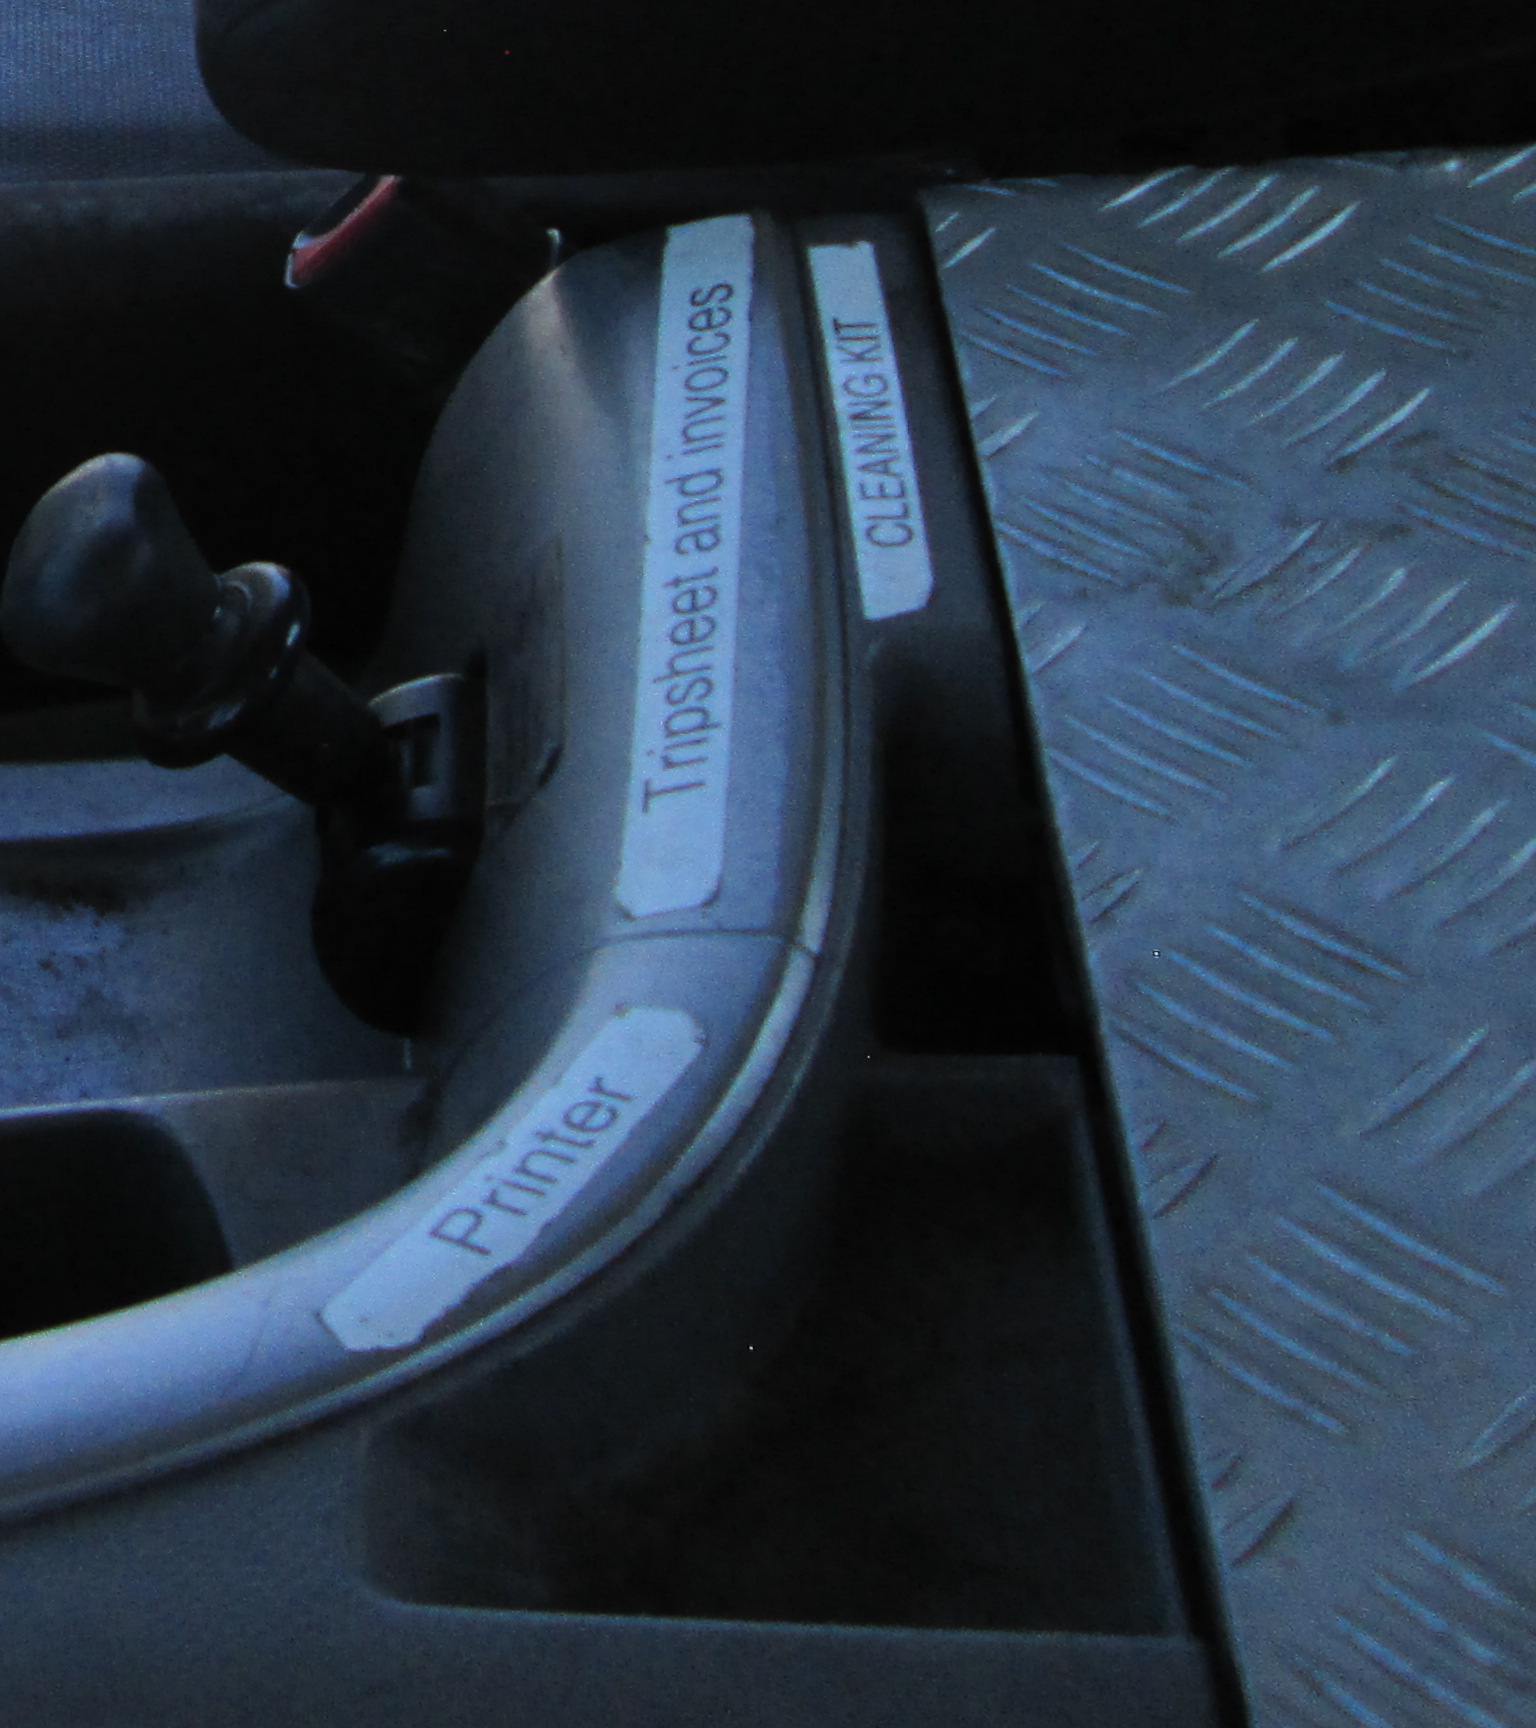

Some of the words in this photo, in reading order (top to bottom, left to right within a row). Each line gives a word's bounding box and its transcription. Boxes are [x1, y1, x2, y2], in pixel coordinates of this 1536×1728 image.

[668, 282, 733, 467] invoices
[832, 318, 885, 365] KIT
[666, 468, 723, 554] and
[839, 373, 914, 549] CLEANING
[642, 567, 726, 814] Tripsheet
[431, 1077, 634, 1257] Printer
